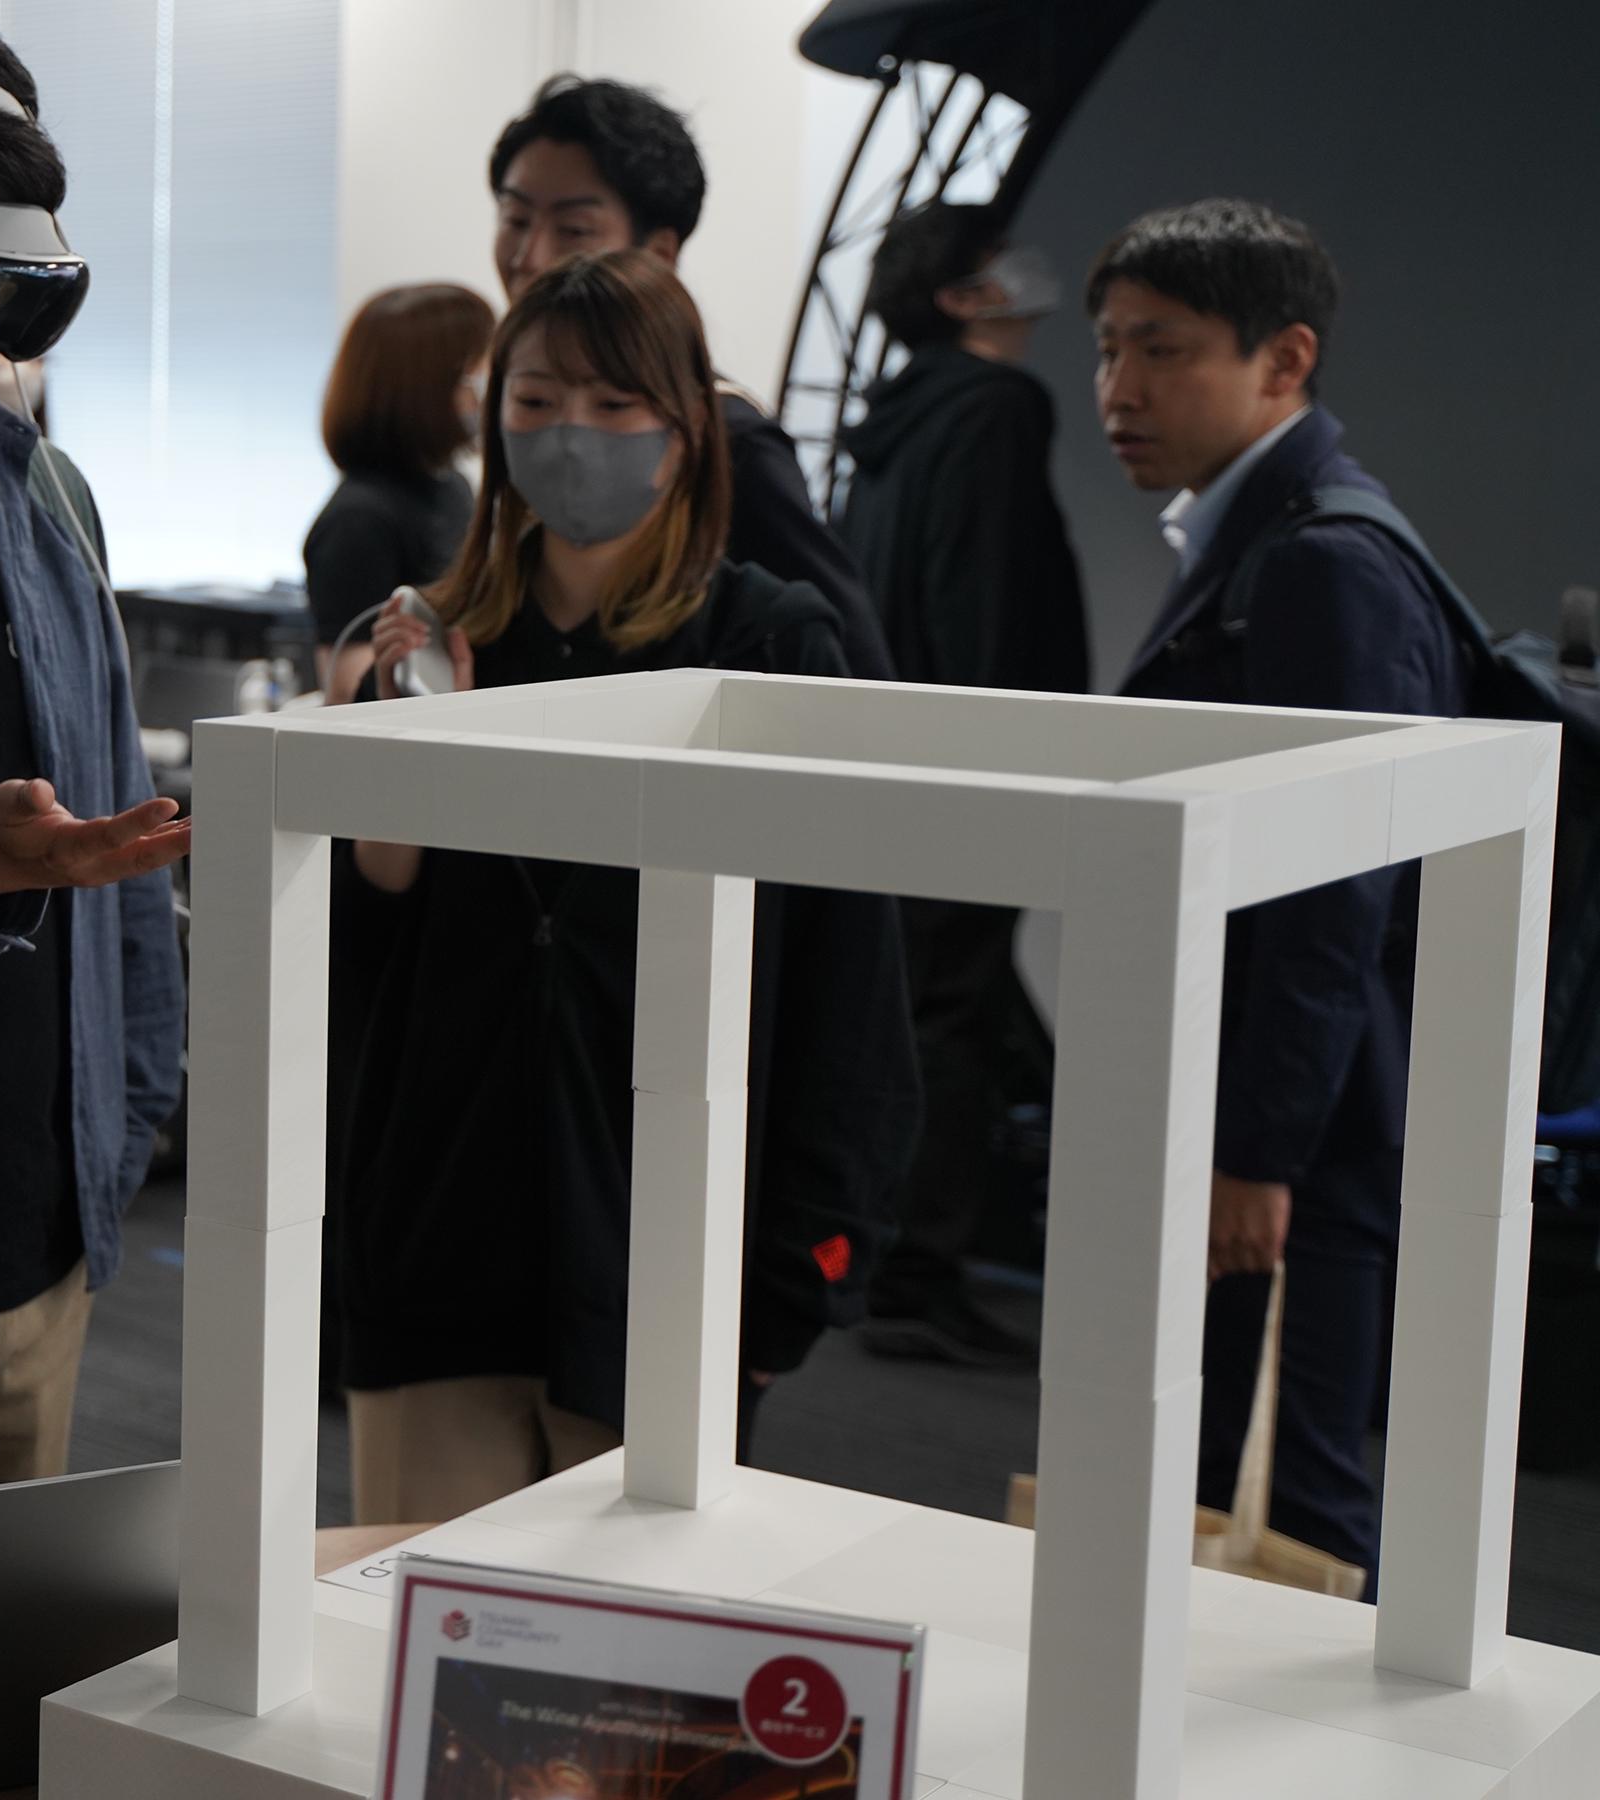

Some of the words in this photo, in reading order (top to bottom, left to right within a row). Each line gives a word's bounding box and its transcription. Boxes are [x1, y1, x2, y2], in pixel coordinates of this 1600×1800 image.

[477, 1623, 561, 1644] COMMUNITY
[781, 1677, 809, 1717] 2
[501, 1700, 532, 1720] The
[535, 1704, 578, 1727] Wine
